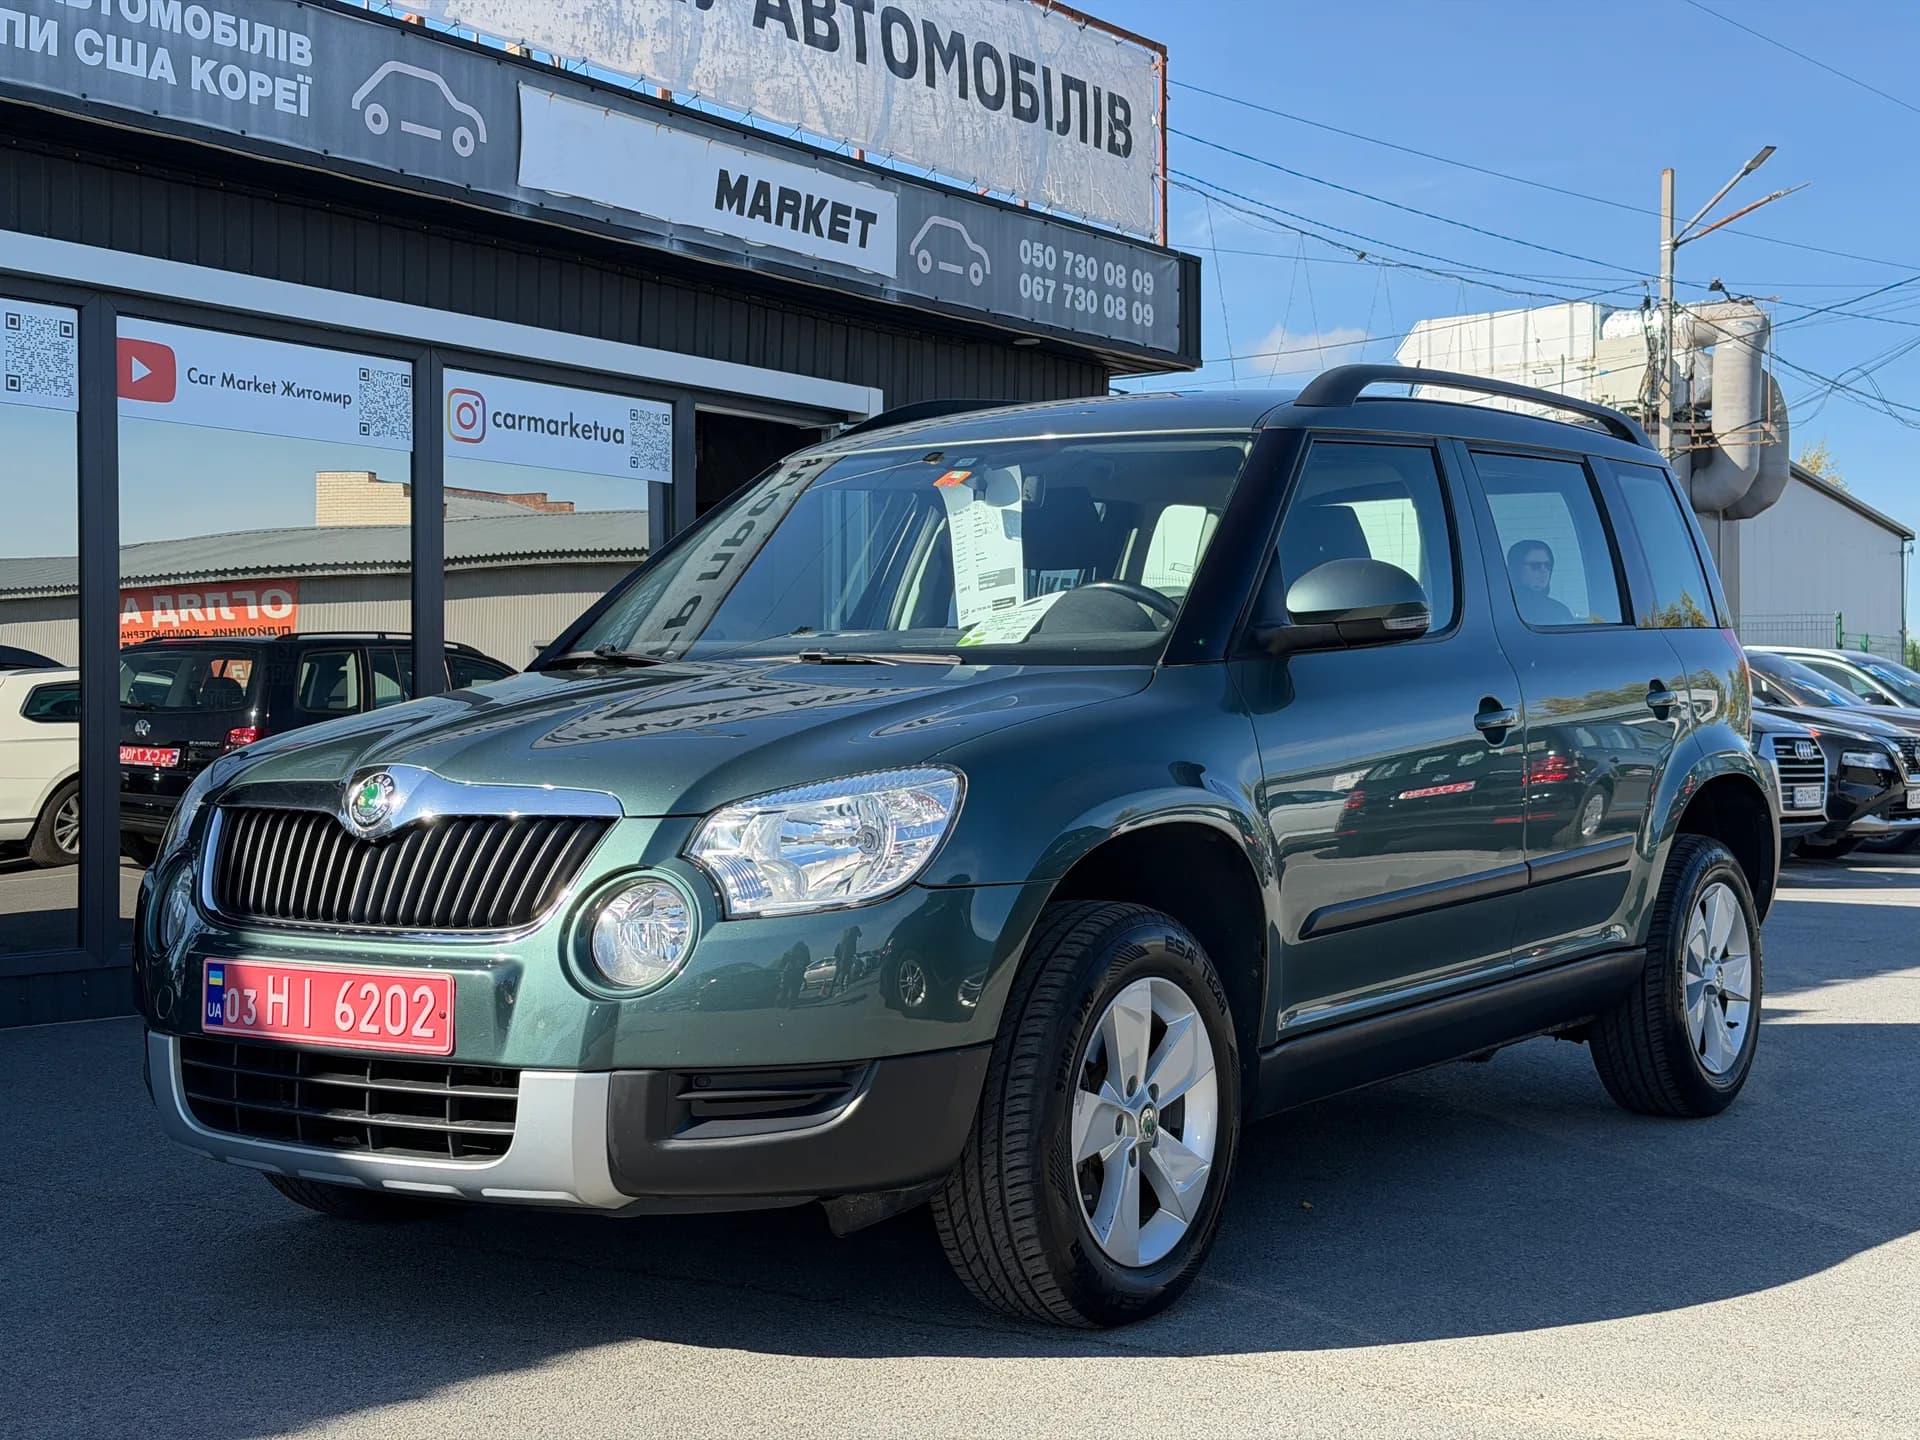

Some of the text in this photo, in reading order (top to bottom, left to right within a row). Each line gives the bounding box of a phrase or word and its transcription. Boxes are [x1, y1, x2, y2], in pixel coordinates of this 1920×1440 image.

[55, 0, 313, 67] ОМОБІЛІВ
[74, 28, 177, 86] США
[191, 56, 313, 118] КОРЕЇ
[714, 168, 878, 250] MARKET
[1019, 239, 1154, 296] 050 730 08 09
[1019, 273, 1154, 327] 067 730 08 09
[187, 367, 353, 409] Car Market Житомир
[492, 411, 625, 445] carmarketua
[207, 1001, 223, 1019] UA
[225, 986, 258, 1026] 03
[333, 979, 436, 1039] 6202
